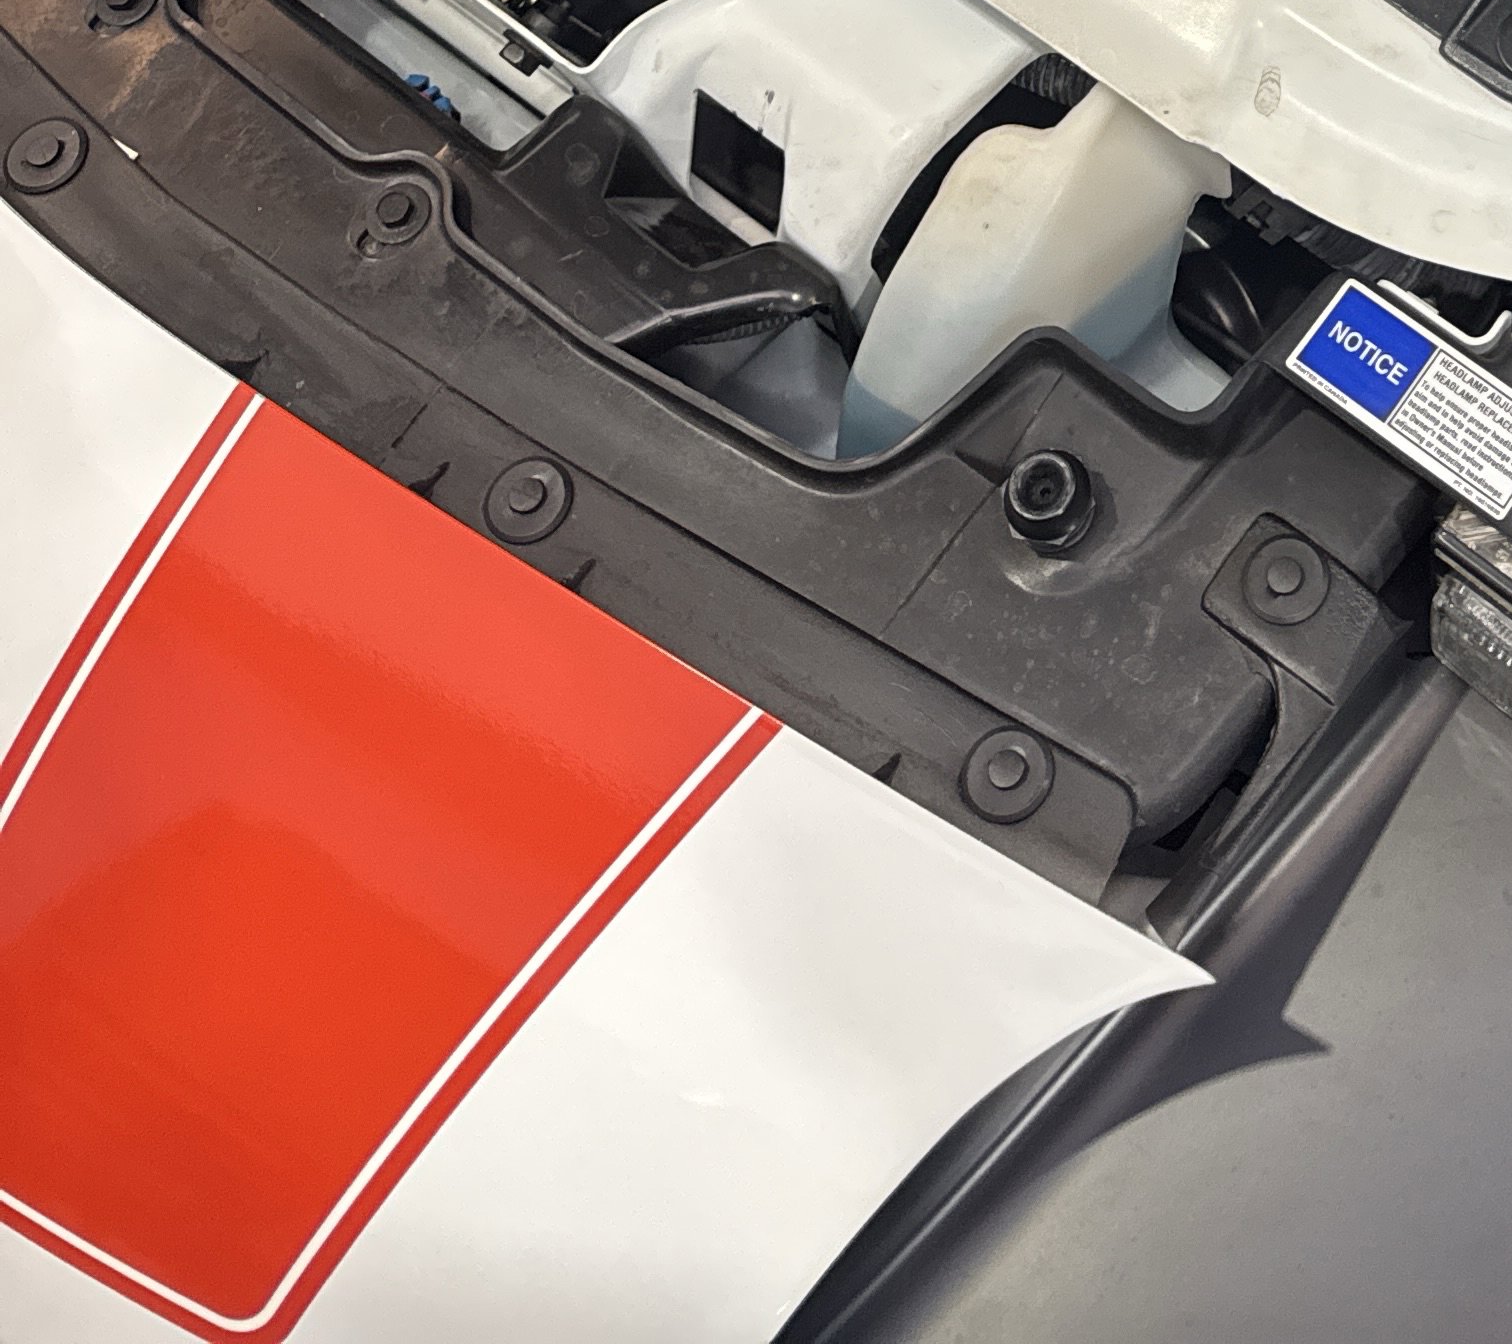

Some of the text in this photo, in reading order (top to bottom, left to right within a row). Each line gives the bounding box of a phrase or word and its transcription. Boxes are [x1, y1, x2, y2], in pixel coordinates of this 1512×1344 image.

[1327, 319, 1407, 384] NOTICE
[1433, 371, 1478, 406] HEADLAMP
[1439, 357, 1488, 395] HEADLAMP
[1407, 399, 1440, 426] headlamp
[1420, 380, 1430, 390] To
[1430, 387, 1445, 402] help
[1468, 415, 1491, 435] proper
[1408, 414, 1436, 437] Owner's
[1436, 434, 1461, 455] Manual
[1461, 452, 1484, 471] before
[1432, 446, 1465, 473] replacing
[1448, 415, 1464, 430] help
[1464, 427, 1483, 443] avoid
[1482, 440, 1510, 463] damage
